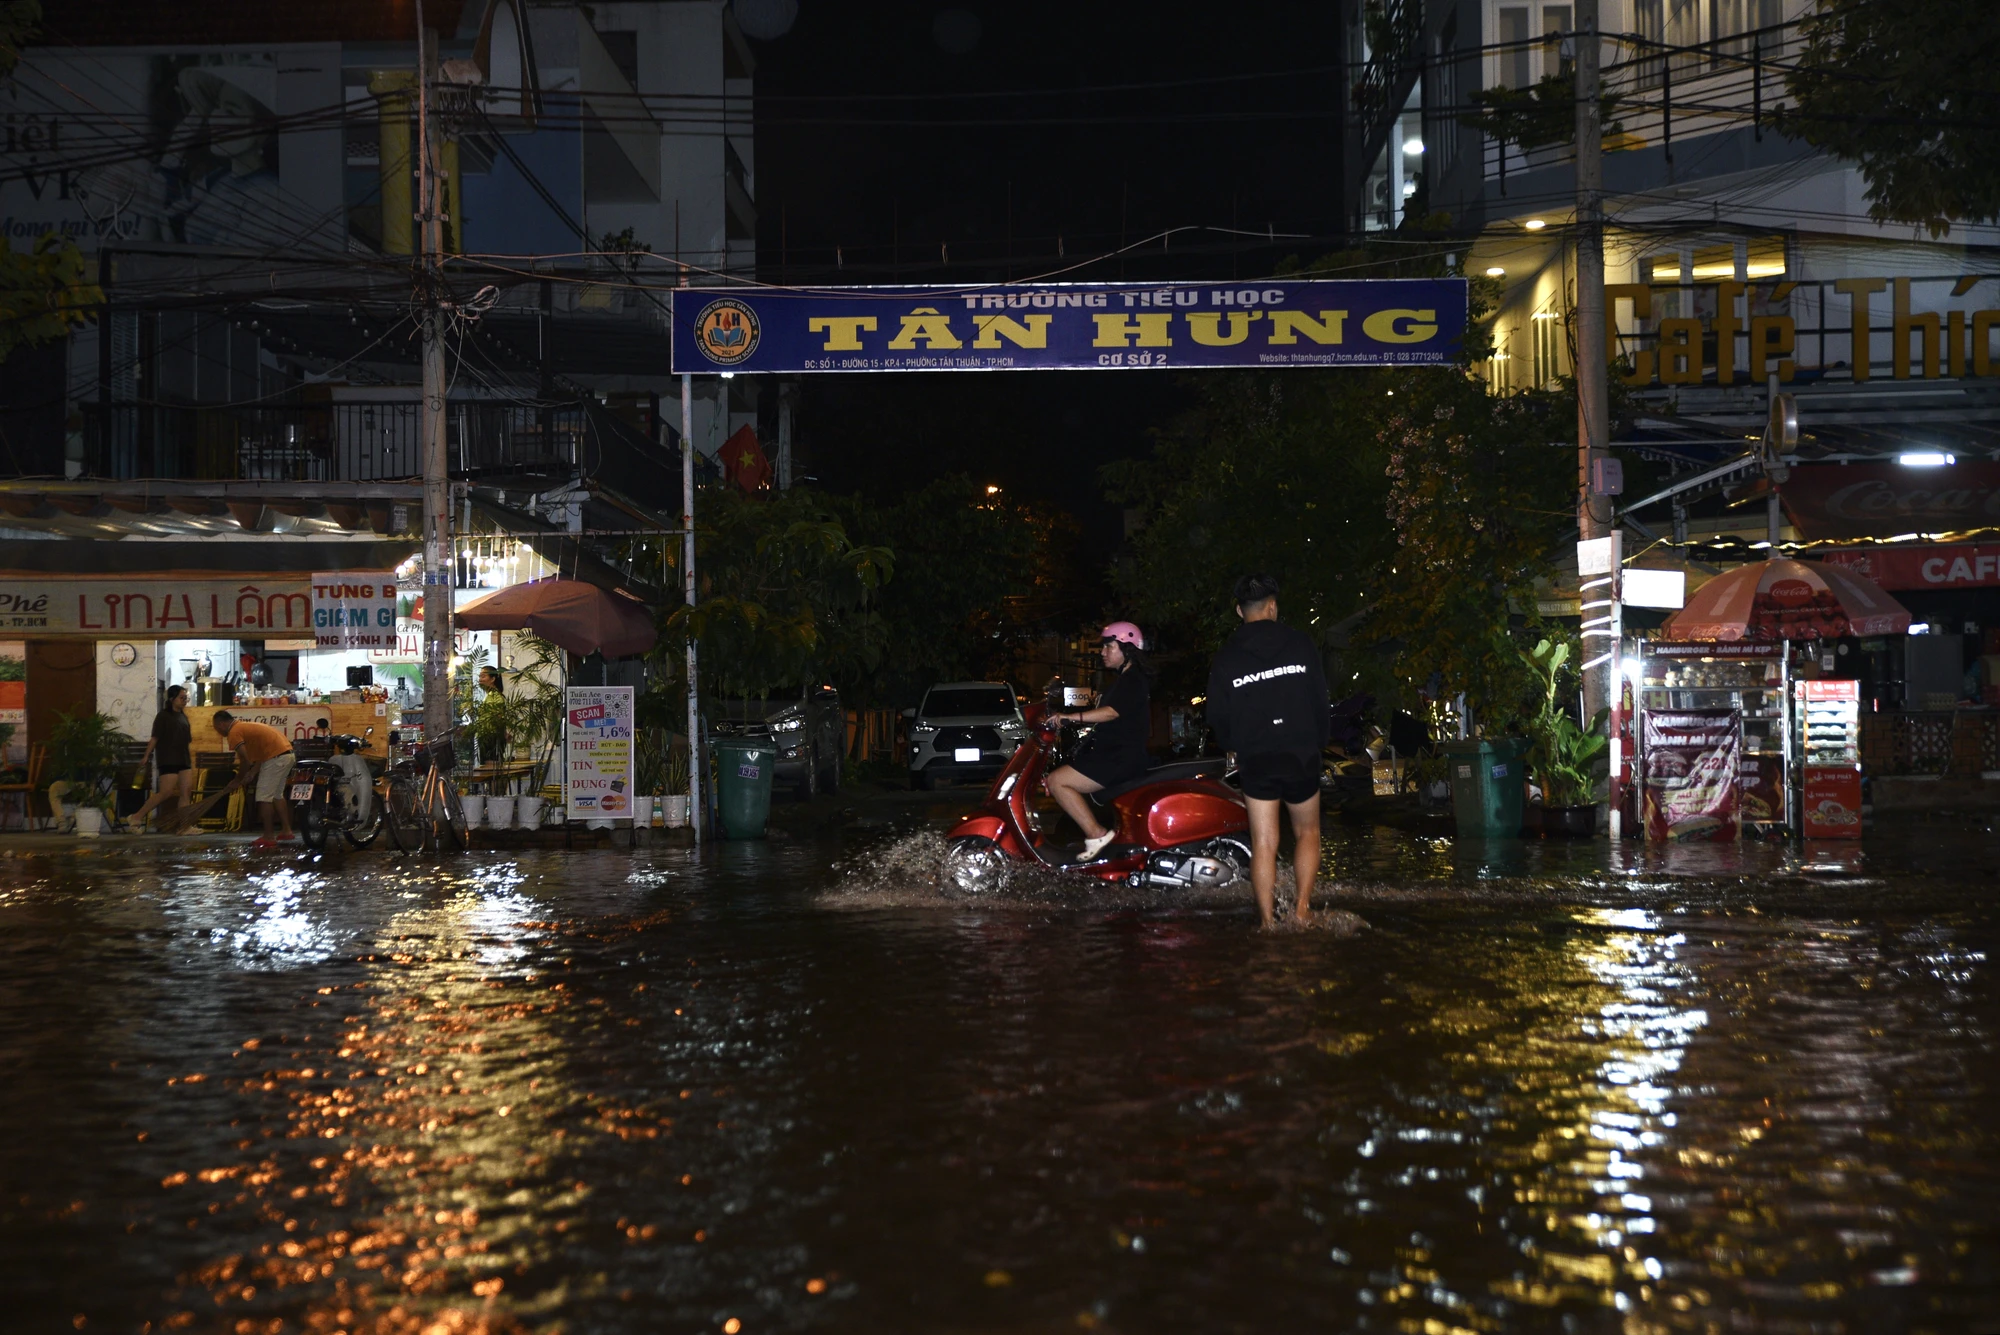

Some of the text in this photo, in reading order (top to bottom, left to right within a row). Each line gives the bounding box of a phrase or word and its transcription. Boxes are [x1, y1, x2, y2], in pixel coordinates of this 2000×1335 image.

[961, 287, 1285, 309] TRƯỜNG TIỂU HỌC
[809, 307, 1439, 351] TÂN HƯNG
[1604, 281, 1799, 386] Café
[718, 355, 743, 363] PRIMARY
[741, 339, 758, 358] SCHOOL
[804, 360, 818, 368] ĐC:
[819, 356, 830, 368] SỐ
[841, 357, 867, 368] ĐƯỜNG
[869, 359, 877, 367] 15
[883, 359, 898, 367] KP.4
[903, 356, 934, 367] PHƯỜNG
[936, 356, 950, 366] TÂN
[952, 355, 977, 368] THUẬN
[982, 357, 1009, 366] TP.HCM
[1099, 350, 1168, 366] CƠ SỞ 2
[1259, 353, 1290, 363] Website:
[1291, 352, 1378, 364] thtanhungq7.hcm.edu.vn
[1383, 352, 1396, 361] ĐT:
[1397, 352, 1410, 361] 028
[1410, 352, 1444, 361] 37712404
[1921, 554, 2000, 583] CAF
[13, 617, 47, 627] TP.HCM
[1656, 646, 1710, 655] HAMBURGER
[1716, 644, 1742, 654] BÁNH
[1742, 644, 1753, 653] MÌ
[1754, 645, 1772, 654] KẸP
[576, 708, 601, 719] SCAN
[1653, 716, 1731, 728] HAMBURGER
[599, 727, 631, 739] 1,6%
[572, 738, 597, 751] THẺ
[571, 759, 593, 771] TÍN
[572, 779, 607, 791] DỤNG
